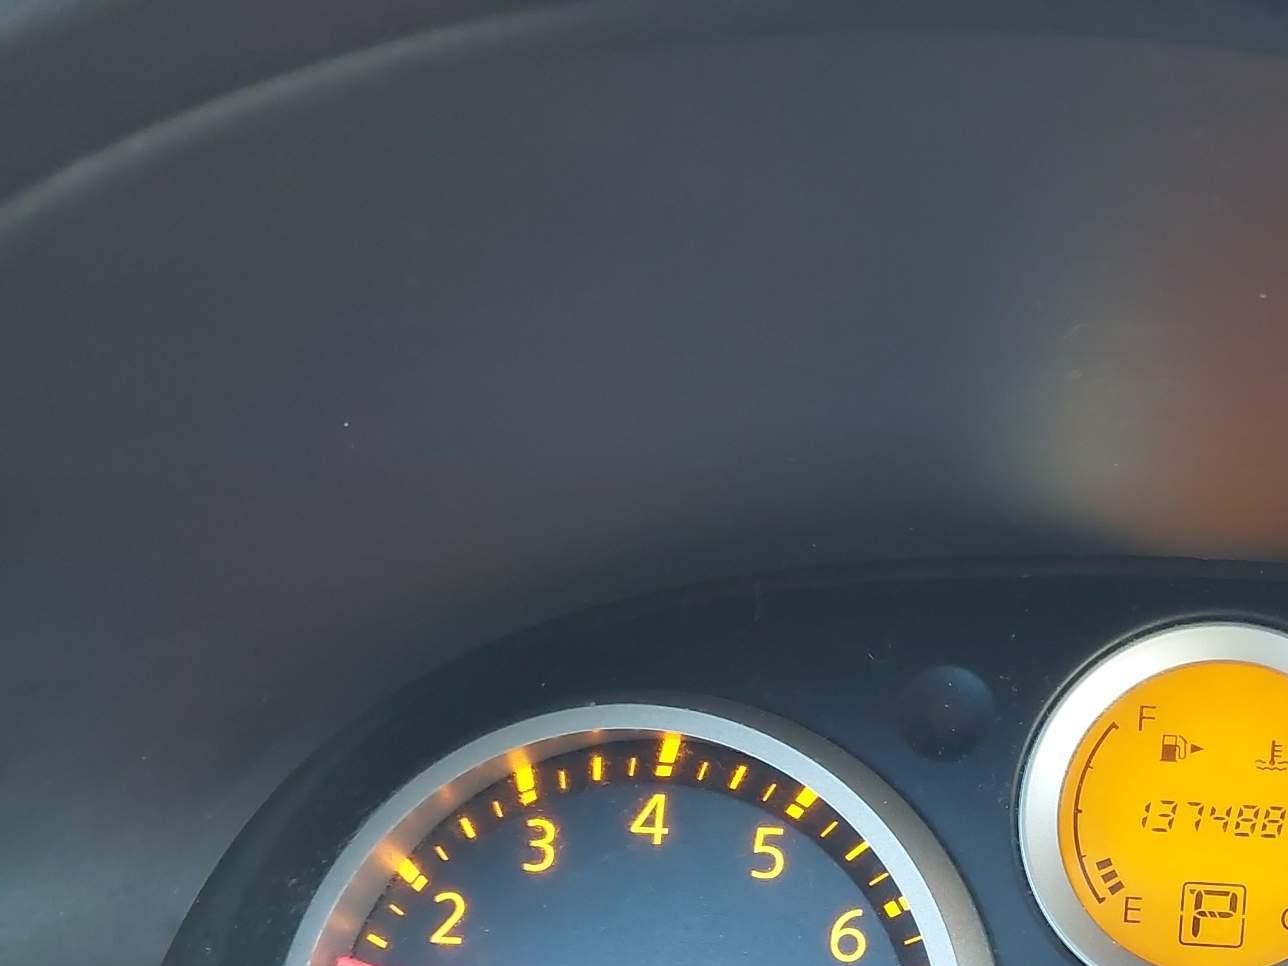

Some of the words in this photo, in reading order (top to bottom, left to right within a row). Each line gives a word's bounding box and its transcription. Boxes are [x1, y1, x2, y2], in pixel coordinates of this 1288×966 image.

[1138, 705, 1156, 731] F
[631, 794, 668, 845] 4
[1141, 800, 1287, 838] 137488
[522, 819, 556, 872] 3
[751, 827, 785, 880] 5
[430, 892, 465, 945] 2
[830, 909, 867, 962] 6
[1124, 897, 1142, 923] E
[1189, 889, 1237, 938] P
